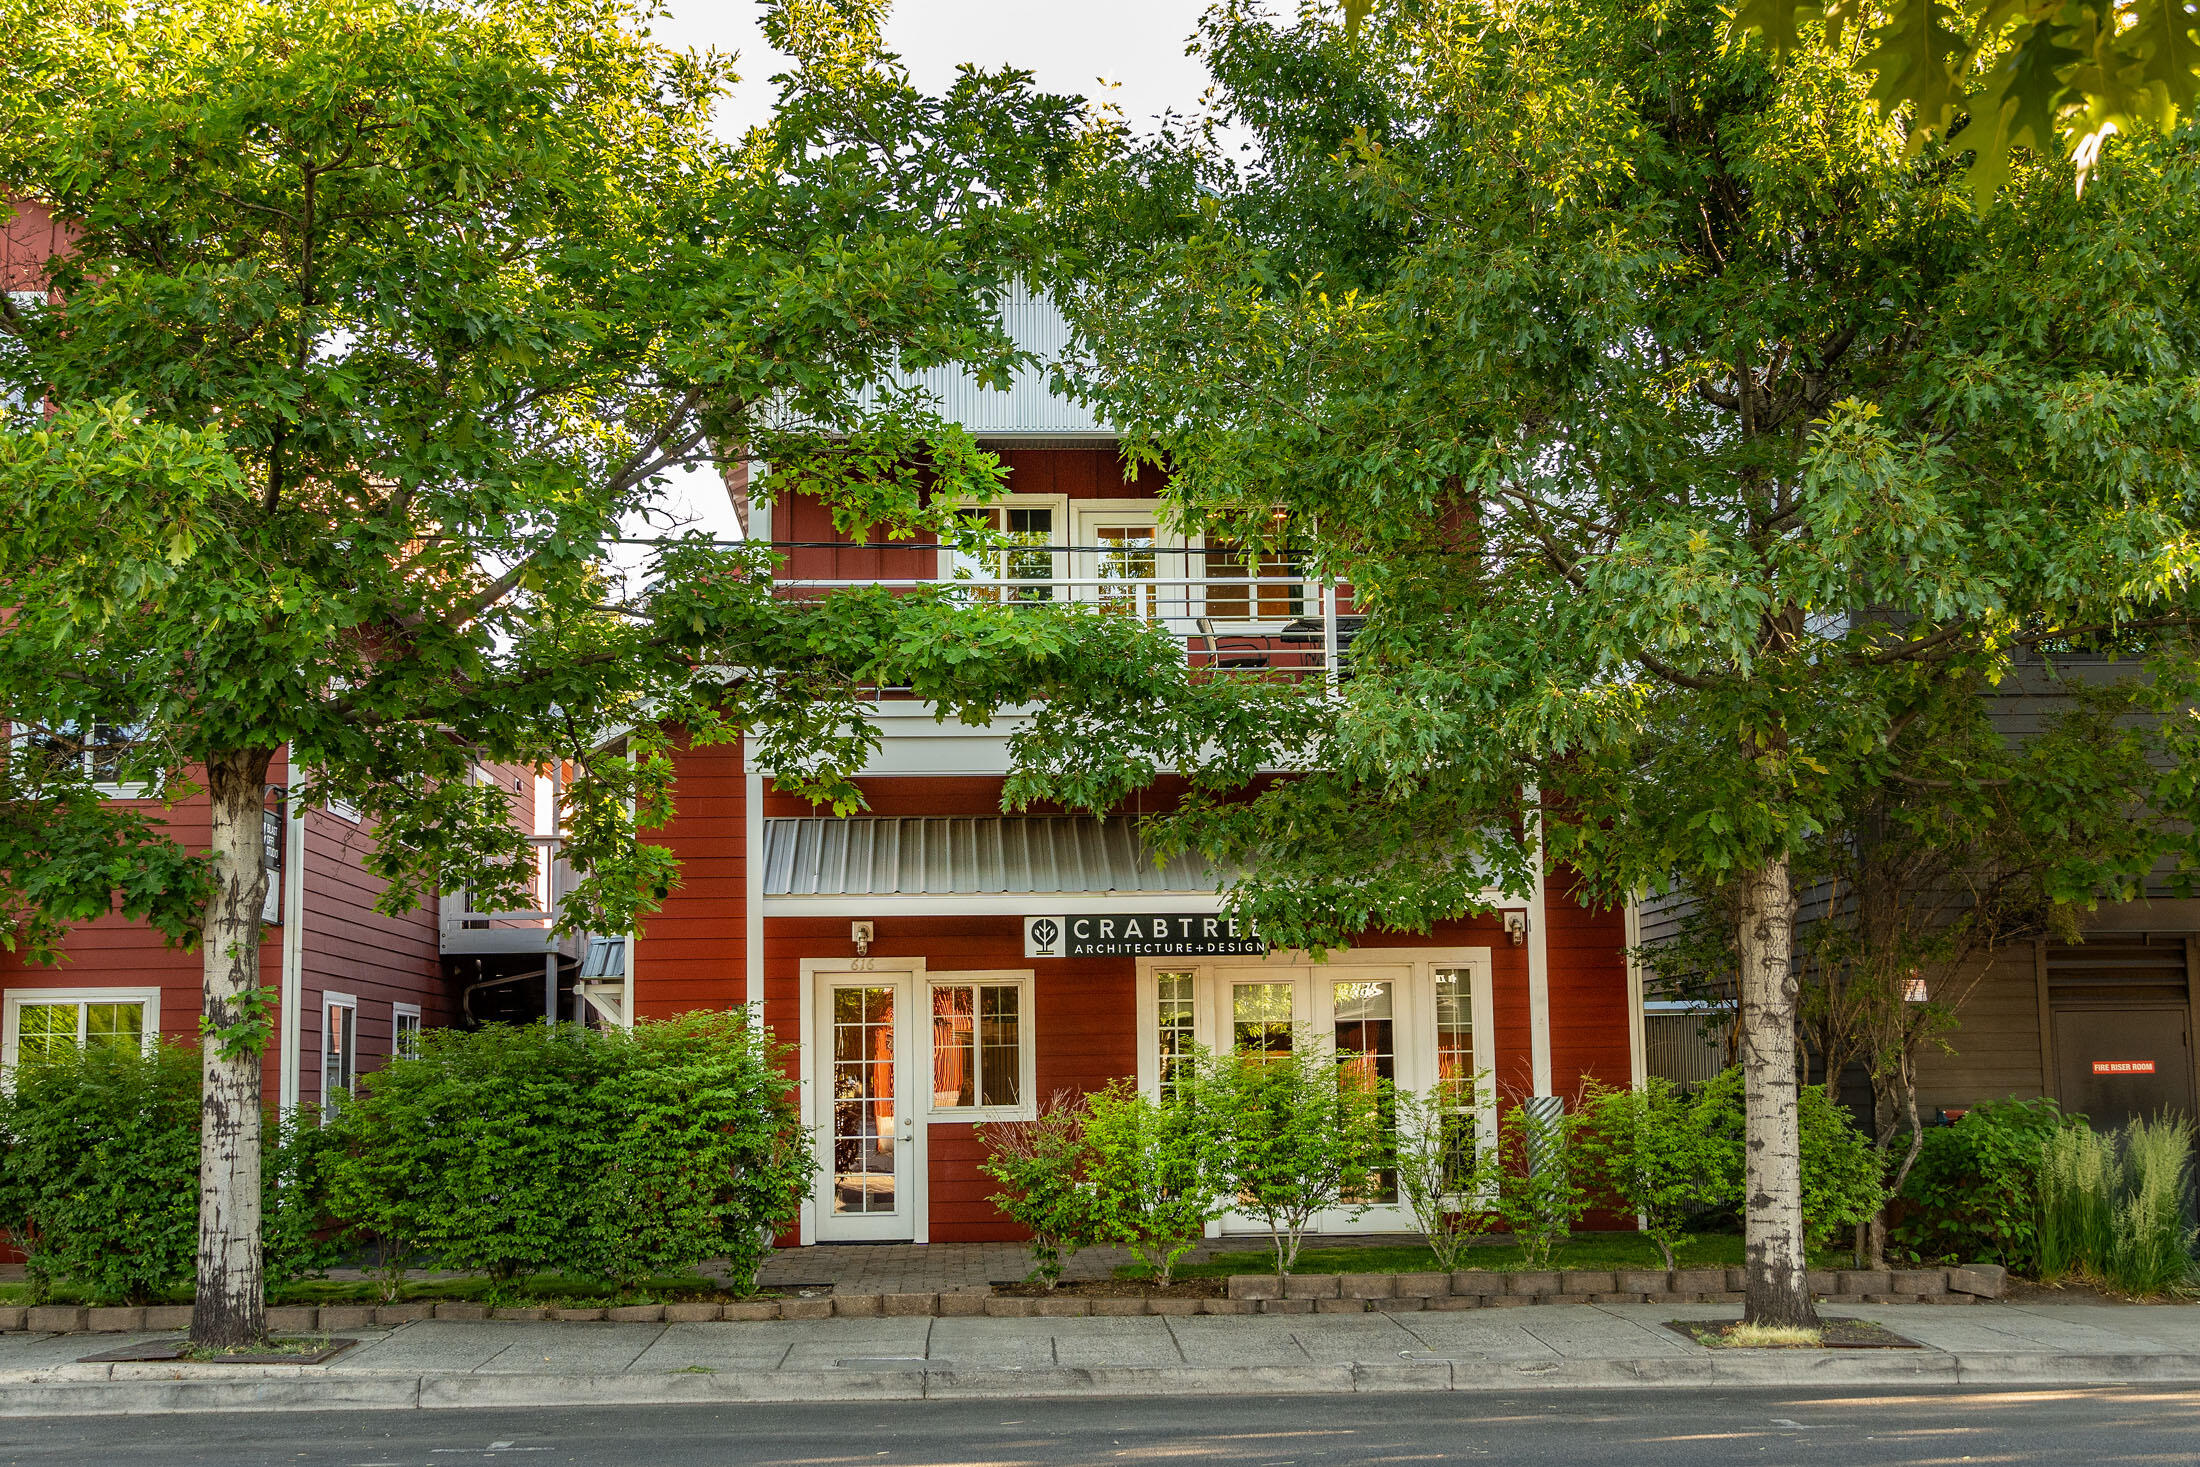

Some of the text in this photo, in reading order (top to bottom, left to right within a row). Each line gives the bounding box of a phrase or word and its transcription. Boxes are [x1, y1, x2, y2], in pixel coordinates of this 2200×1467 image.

[851, 958, 874, 971] 616
[2111, 1063, 2131, 1071] RISER
[2132, 1063, 2153, 1071] ROOM
